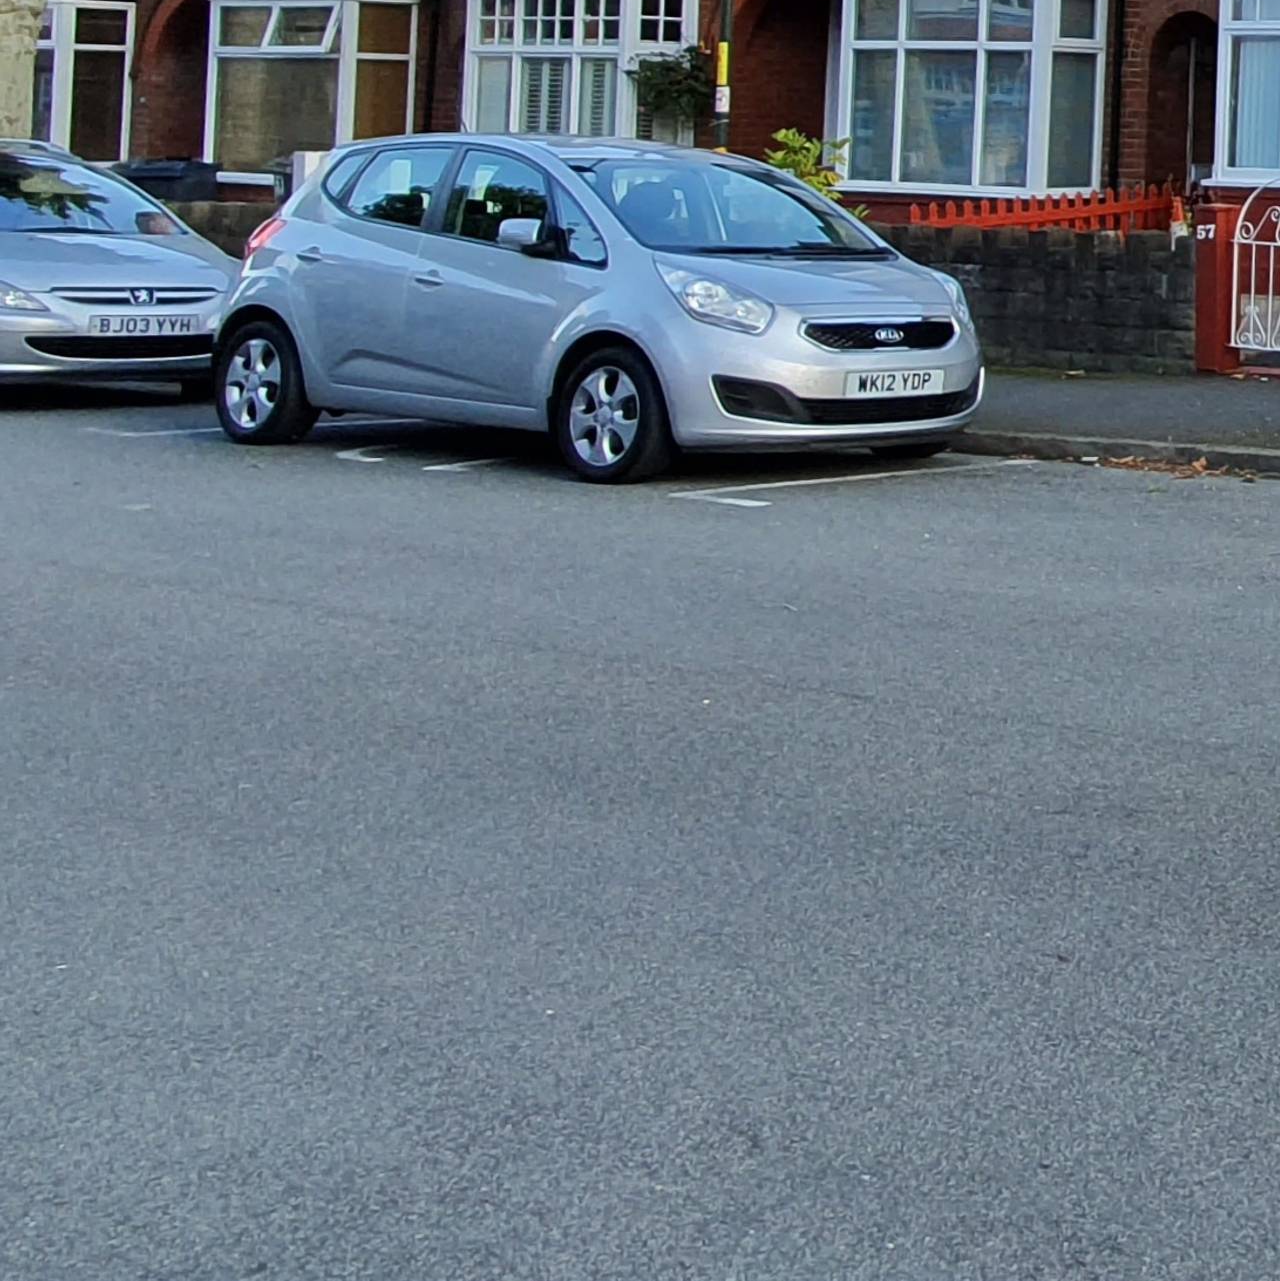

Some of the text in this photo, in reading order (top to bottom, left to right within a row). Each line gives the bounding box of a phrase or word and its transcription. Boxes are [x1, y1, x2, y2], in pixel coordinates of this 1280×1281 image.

[1196, 224, 1216, 240] 57
[98, 317, 191, 334] BJ03 YYH
[877, 328, 902, 341] KIA
[857, 371, 932, 393] WK12 YDP
